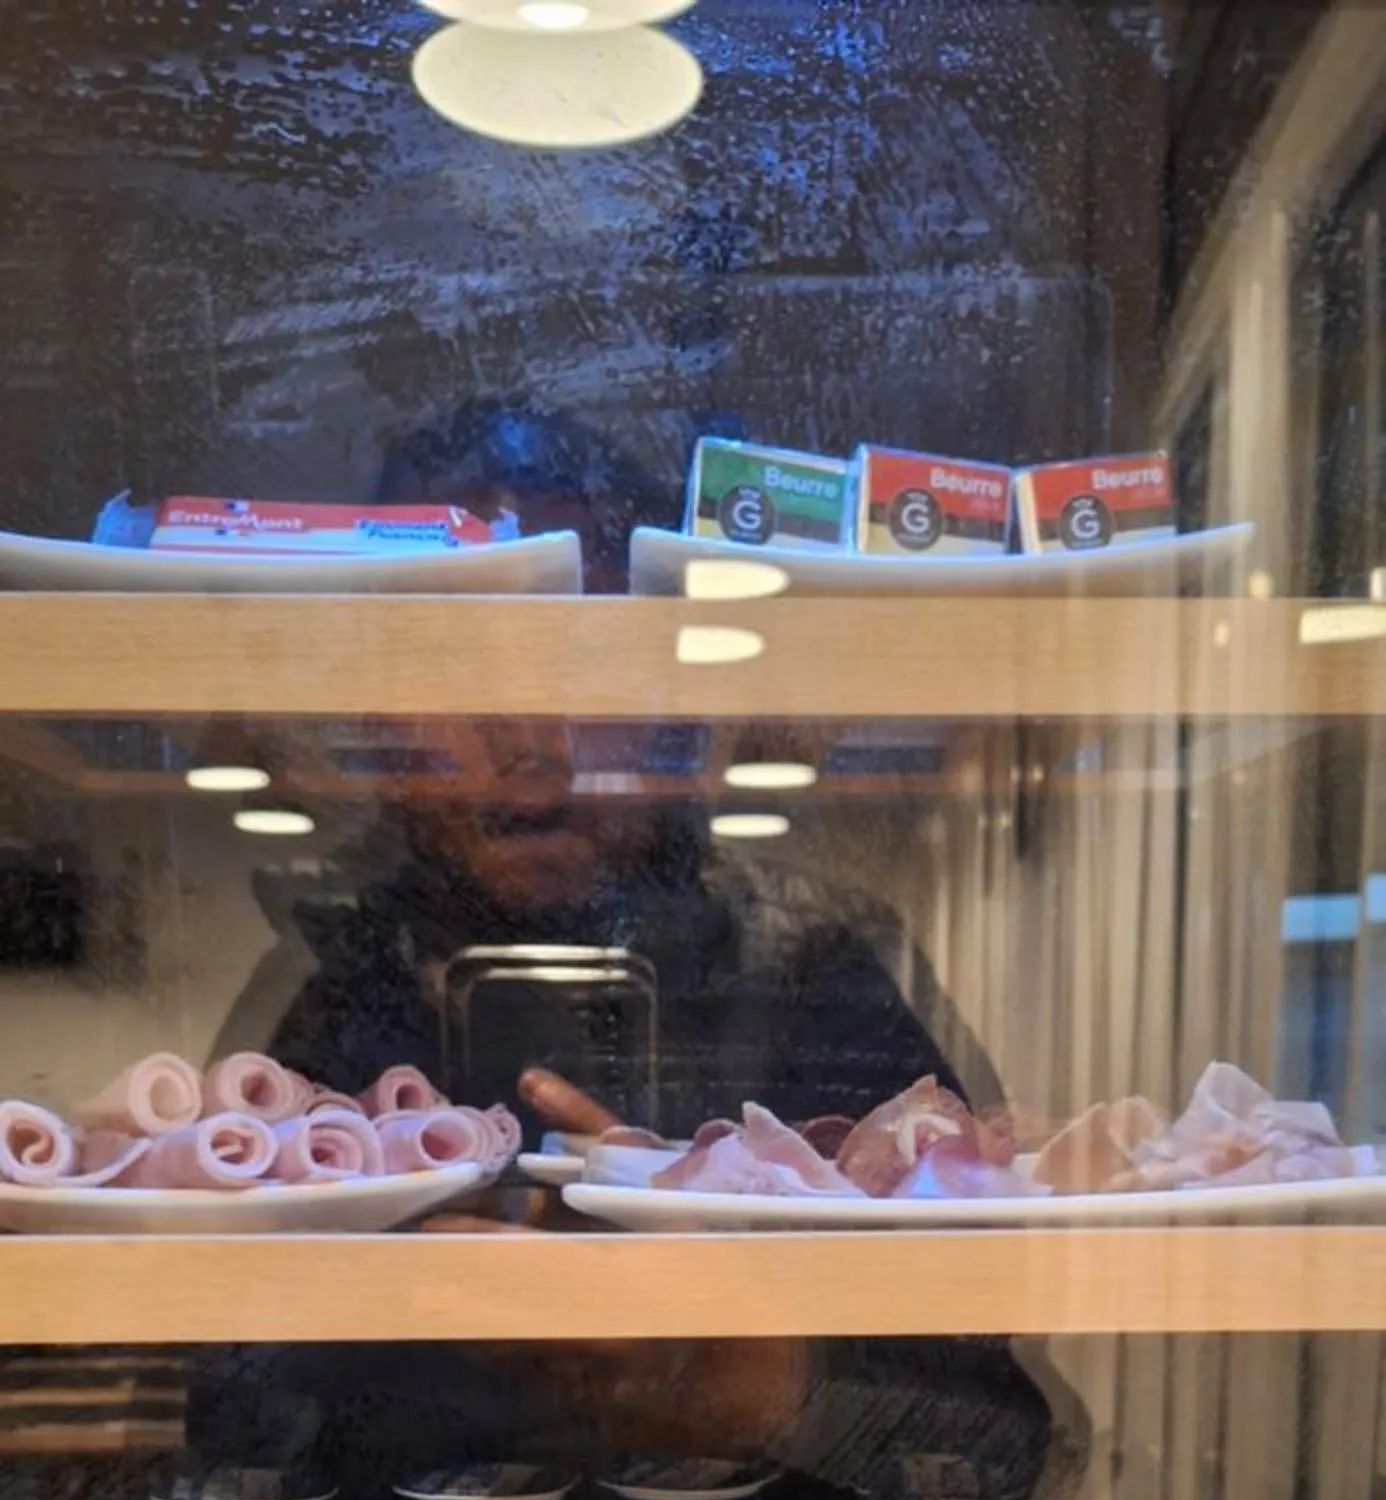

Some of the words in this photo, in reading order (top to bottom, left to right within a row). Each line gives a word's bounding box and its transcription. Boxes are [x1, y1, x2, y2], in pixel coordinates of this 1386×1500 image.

[764, 465, 838, 499] Beurre
[930, 467, 1002, 498] Beurre
[1092, 466, 1165, 490] Beurre
[732, 500, 762, 529] G
[899, 500, 931, 533] G
[1071, 510, 1100, 538] G
